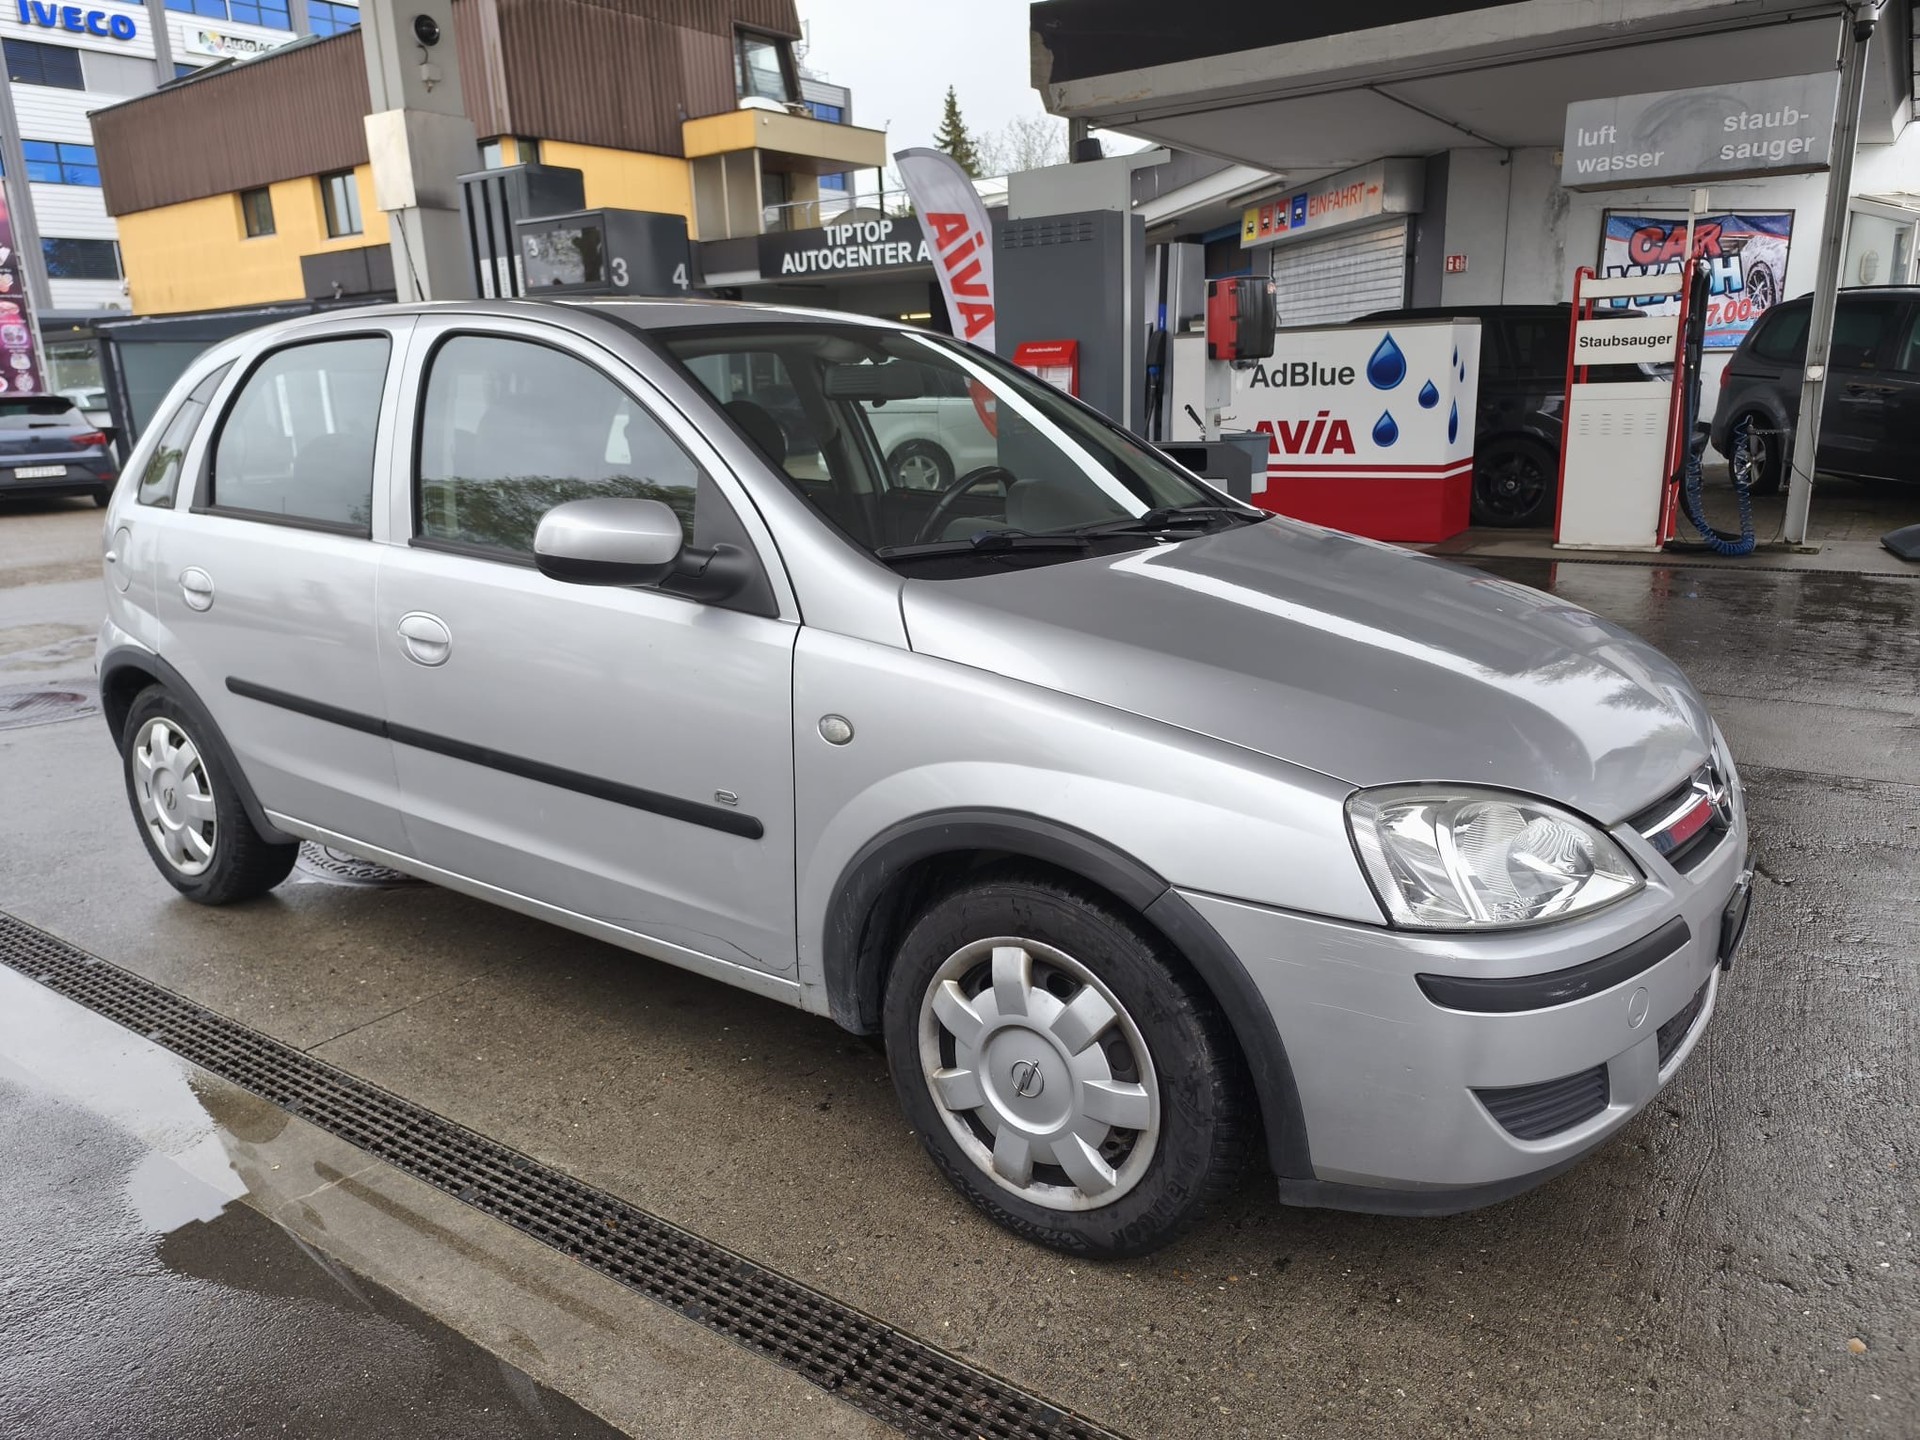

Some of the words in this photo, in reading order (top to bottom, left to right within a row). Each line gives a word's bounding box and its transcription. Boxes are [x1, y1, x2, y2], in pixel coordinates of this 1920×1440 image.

[18, 0, 136, 40] IVECO
[1723, 105, 1809, 132] staub-
[1577, 125, 1617, 147] luft
[1720, 136, 1816, 161] sauger
[1577, 150, 1665, 173] wasser
[1308, 182, 1366, 217] EINFAHRT
[823, 220, 893, 246] TIPTOP
[1629, 222, 1723, 265] CAR
[528, 238, 539, 256] 3
[781, 241, 913, 274] AUTOCENTER
[612, 257, 629, 287] 3
[672, 263, 689, 290] 4
[1707, 298, 1752, 326] 7.00
[1579, 335, 1673, 348] Staubsauger
[1250, 362, 1355, 388] AdBlue
